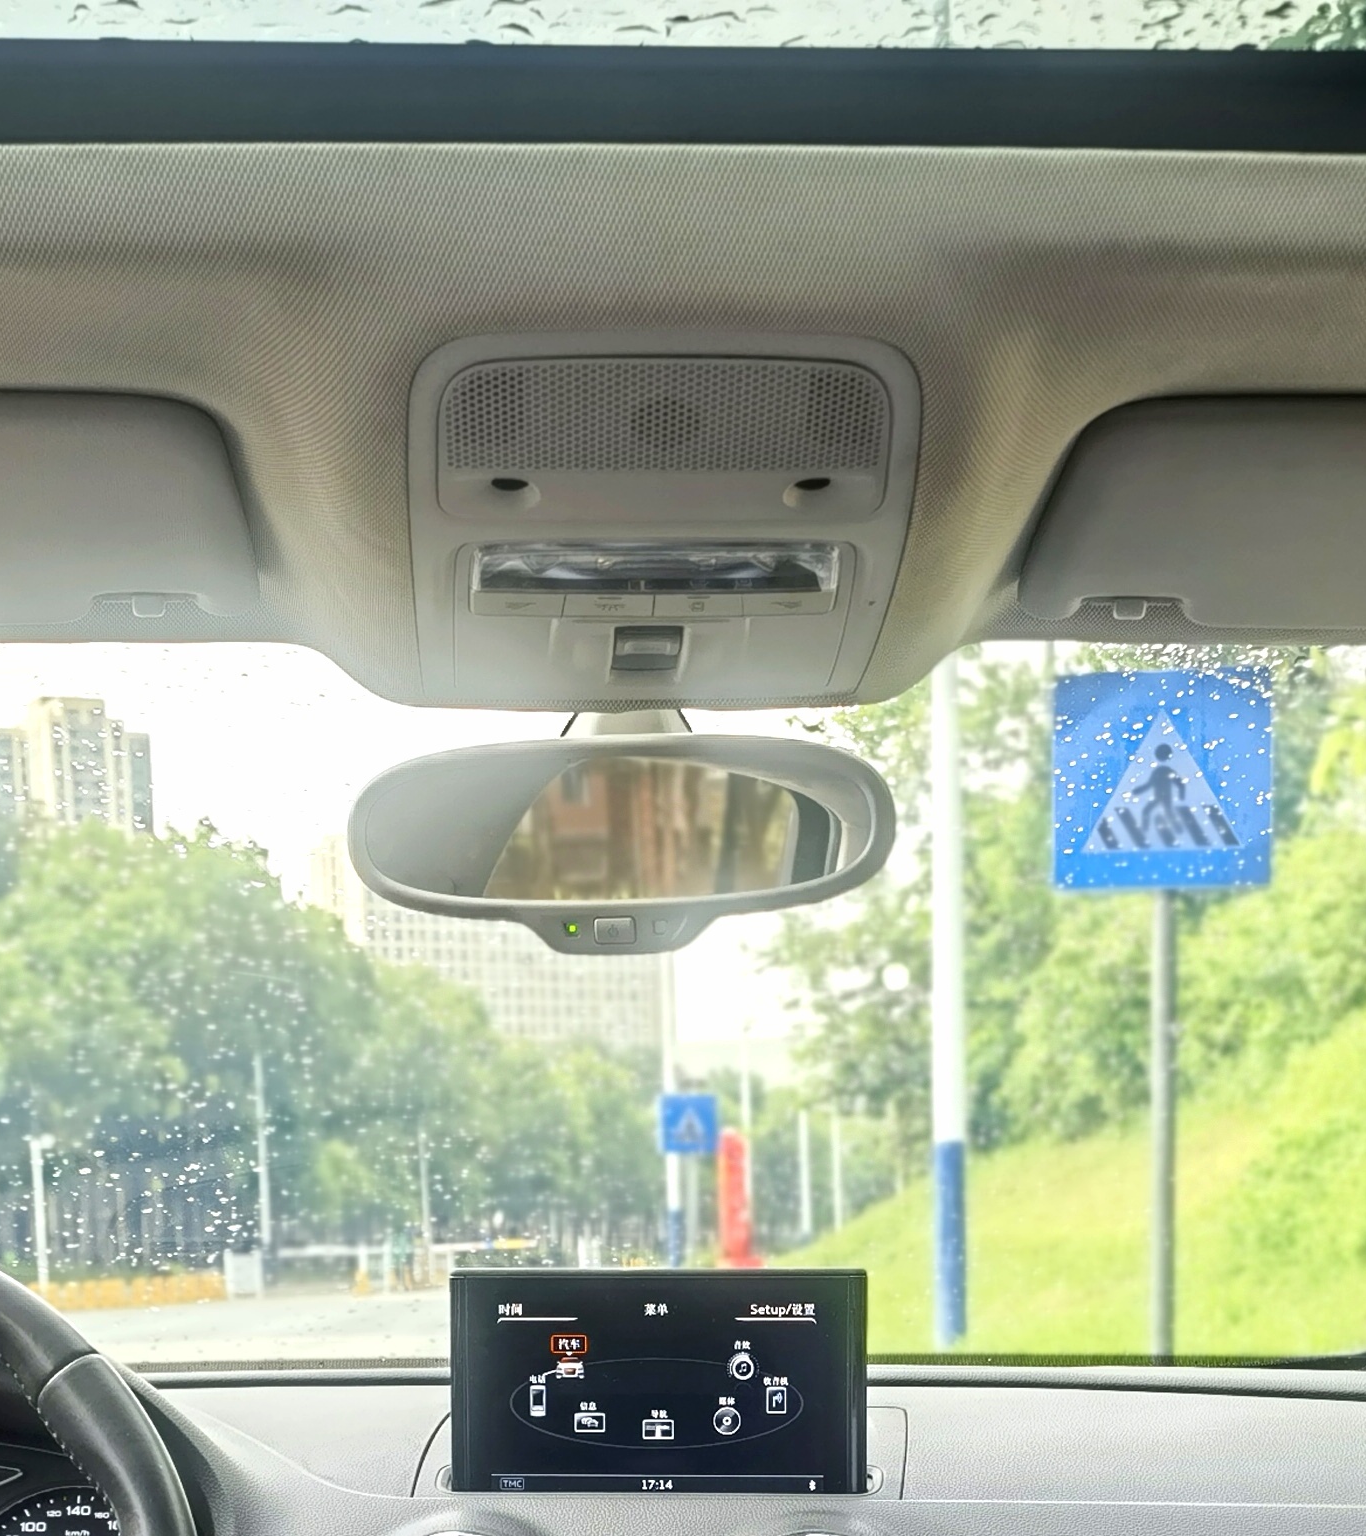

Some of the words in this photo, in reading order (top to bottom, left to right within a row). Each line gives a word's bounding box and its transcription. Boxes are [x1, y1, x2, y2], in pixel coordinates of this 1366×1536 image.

[497, 1302, 523, 1316] 时间
[643, 1303, 669, 1316] 菜单
[750, 1303, 816, 1318] Setup/设置
[558, 1338, 581, 1350] 汽车
[502, 1479, 524, 1489] TMC
[641, 1479, 674, 1490] 17:14
[65, 1505, 91, 1516] 140
[19, 1521, 47, 1533] 100
[64, 1529, 91, 1536] km/h
